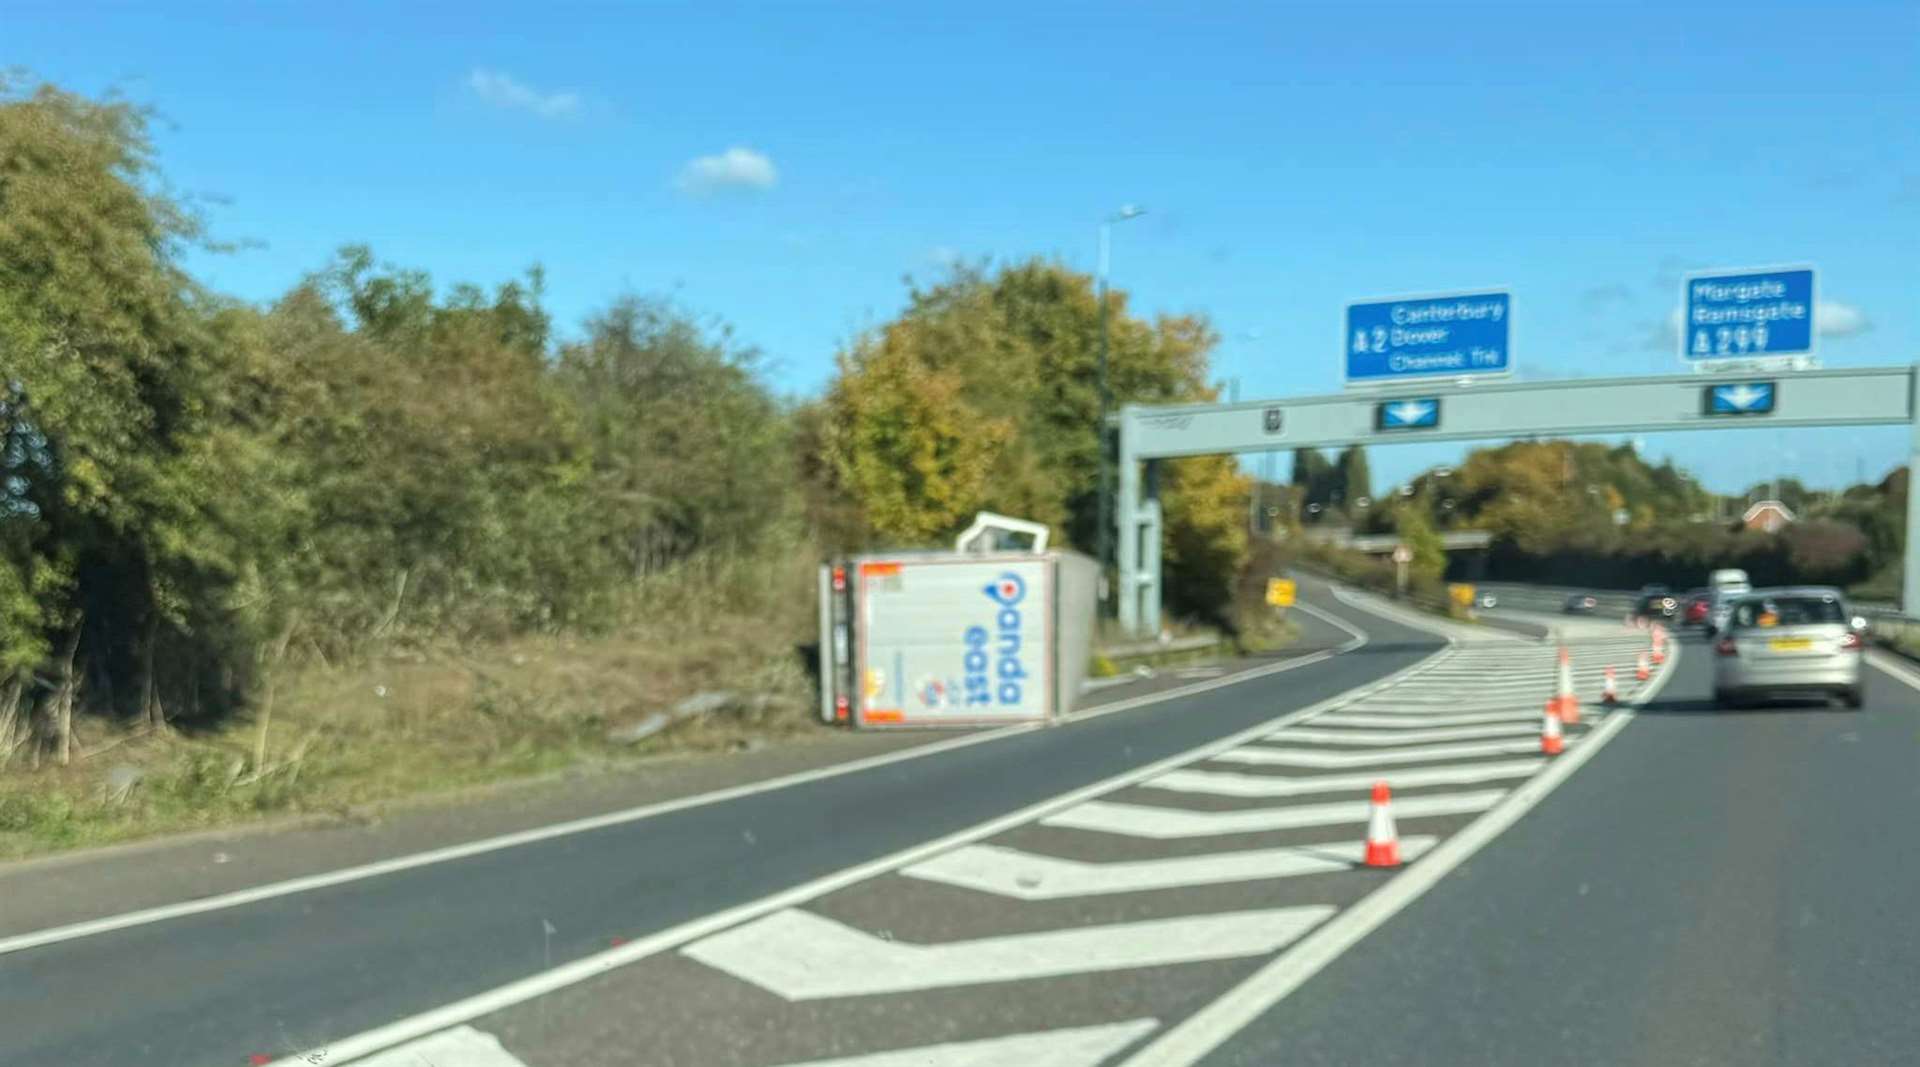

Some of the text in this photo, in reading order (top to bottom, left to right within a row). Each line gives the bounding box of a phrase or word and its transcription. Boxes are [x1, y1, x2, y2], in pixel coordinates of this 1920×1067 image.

[1694, 281, 1786, 302] Margate
[1392, 304, 1504, 324] Canterbury
[1694, 303, 1805, 323] Ramsgate
[1392, 329, 1449, 346] Dover
[965, 627, 989, 706] east
